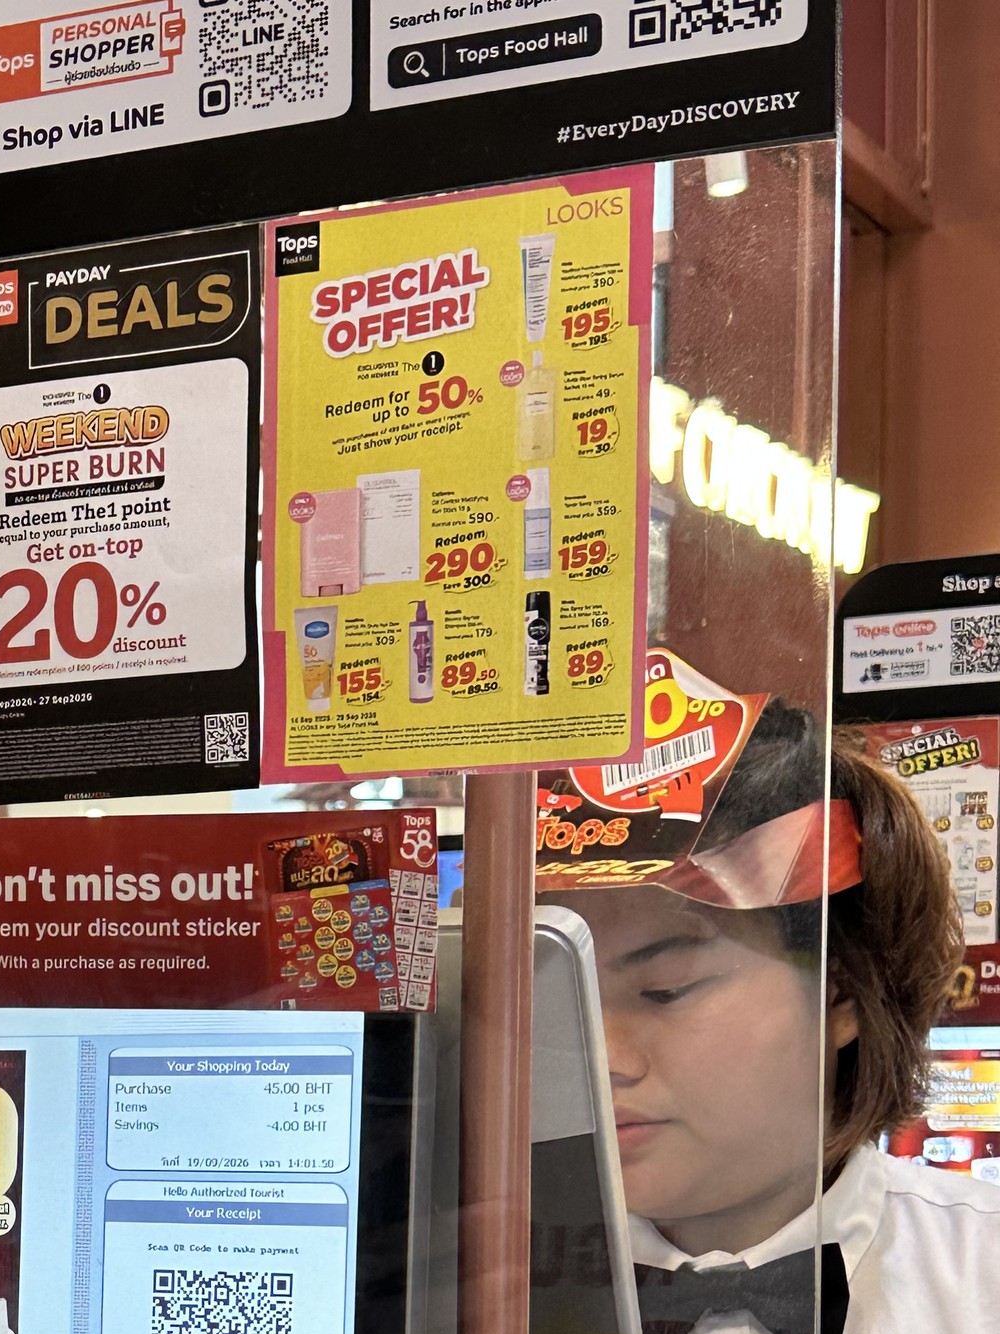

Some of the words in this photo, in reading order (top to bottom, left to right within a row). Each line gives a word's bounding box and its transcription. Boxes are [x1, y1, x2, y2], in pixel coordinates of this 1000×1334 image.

[52, 12, 157, 44] PERSONAL
[390, 9, 440, 29] Search
[444, 6, 465, 20] for
[470, 3, 483, 15] in
[242, 23, 284, 47] LINE
[456, 42, 499, 64] Tops
[505, 34, 549, 56] Food
[554, 26, 589, 49] Hall
[49, 34, 155, 69] SHOPPER
[2, 124, 62, 151] Shop
[69, 118, 103, 140] via
[110, 104, 165, 133] LINE
[557, 90, 801, 145] #EveryDayDISCOVERY
[547, 196, 623, 226] LOOKS
[277, 234, 318, 253] Tops
[46, 265, 111, 287] PAYDAY
[316, 250, 485, 318] SPECIAL
[46, 274, 233, 345] DEALS
[566, 297, 608, 313] Redeem
[328, 293, 470, 352] OFFER!
[325, 396, 384, 418] Redeem
[389, 390, 410, 404] for
[373, 409, 390, 423] up
[395, 406, 409, 417] to
[572, 405, 615, 420] Redeem
[1, 406, 169, 459] WEEKEND
[337, 441, 361, 455] Just
[364, 436, 392, 449] show
[394, 430, 418, 445] your
[421, 421, 463, 437] receipt.
[4, 459, 79, 489] SUPER
[89, 448, 165, 480] BURN
[0, 510, 67, 530] Redeem
[72, 503, 117, 521] The1
[122, 497, 171, 520] point
[0, 530, 27, 545] equal
[30, 531, 40, 540] to
[43, 527, 67, 541] your
[71, 522, 121, 538] purchase
[124, 517, 170, 530] amount,
[435, 530, 485, 548] Redeem
[27, 543, 64, 561] Get
[69, 537, 143, 559] on-top
[942, 576, 990, 593] Shop
[113, 634, 186, 653] discount
[854, 625, 890, 640] Tops
[881, 729, 960, 761] SPECIAL
[899, 740, 979, 775] OFFER!
[404, 815, 431, 828] Tops
[65, 866, 162, 901] miss
[171, 863, 256, 900] out!
[36, 920, 82, 941] your
[88, 917, 178, 937] discount
[186, 917, 261, 937] sticker
[32, 958, 40, 969] a
[44, 955, 114, 976] purchase
[119, 957, 135, 969] as
[140, 955, 210, 976] required.
[167, 1061, 194, 1072] Your
[197, 1061, 251, 1074] Shopping
[255, 1060, 290, 1073] Today
[115, 1083, 171, 1095] Purchase
[264, 1083, 299, 1095] 45.00
[305, 1083, 333, 1095] BHT
[115, 1102, 147, 1112] Items
[293, 1102, 298, 1112] 1
[304, 1103, 324, 1114] pcs
[114, 1120, 159, 1132] Savings
[266, 1120, 299, 1132] -4.00
[303, 1120, 327, 1132] BHT
[164, 1187, 188, 1196] Hello
[191, 1187, 246, 1197] Authorized
[250, 1188, 284, 1197] Tourist
[186, 1207, 214, 1218] Your
[216, 1207, 261, 1220] Receipt
[147, 1243, 168, 1252] Scan
[174, 1244, 184, 1252] QR
[190, 1244, 211, 1252] Code
